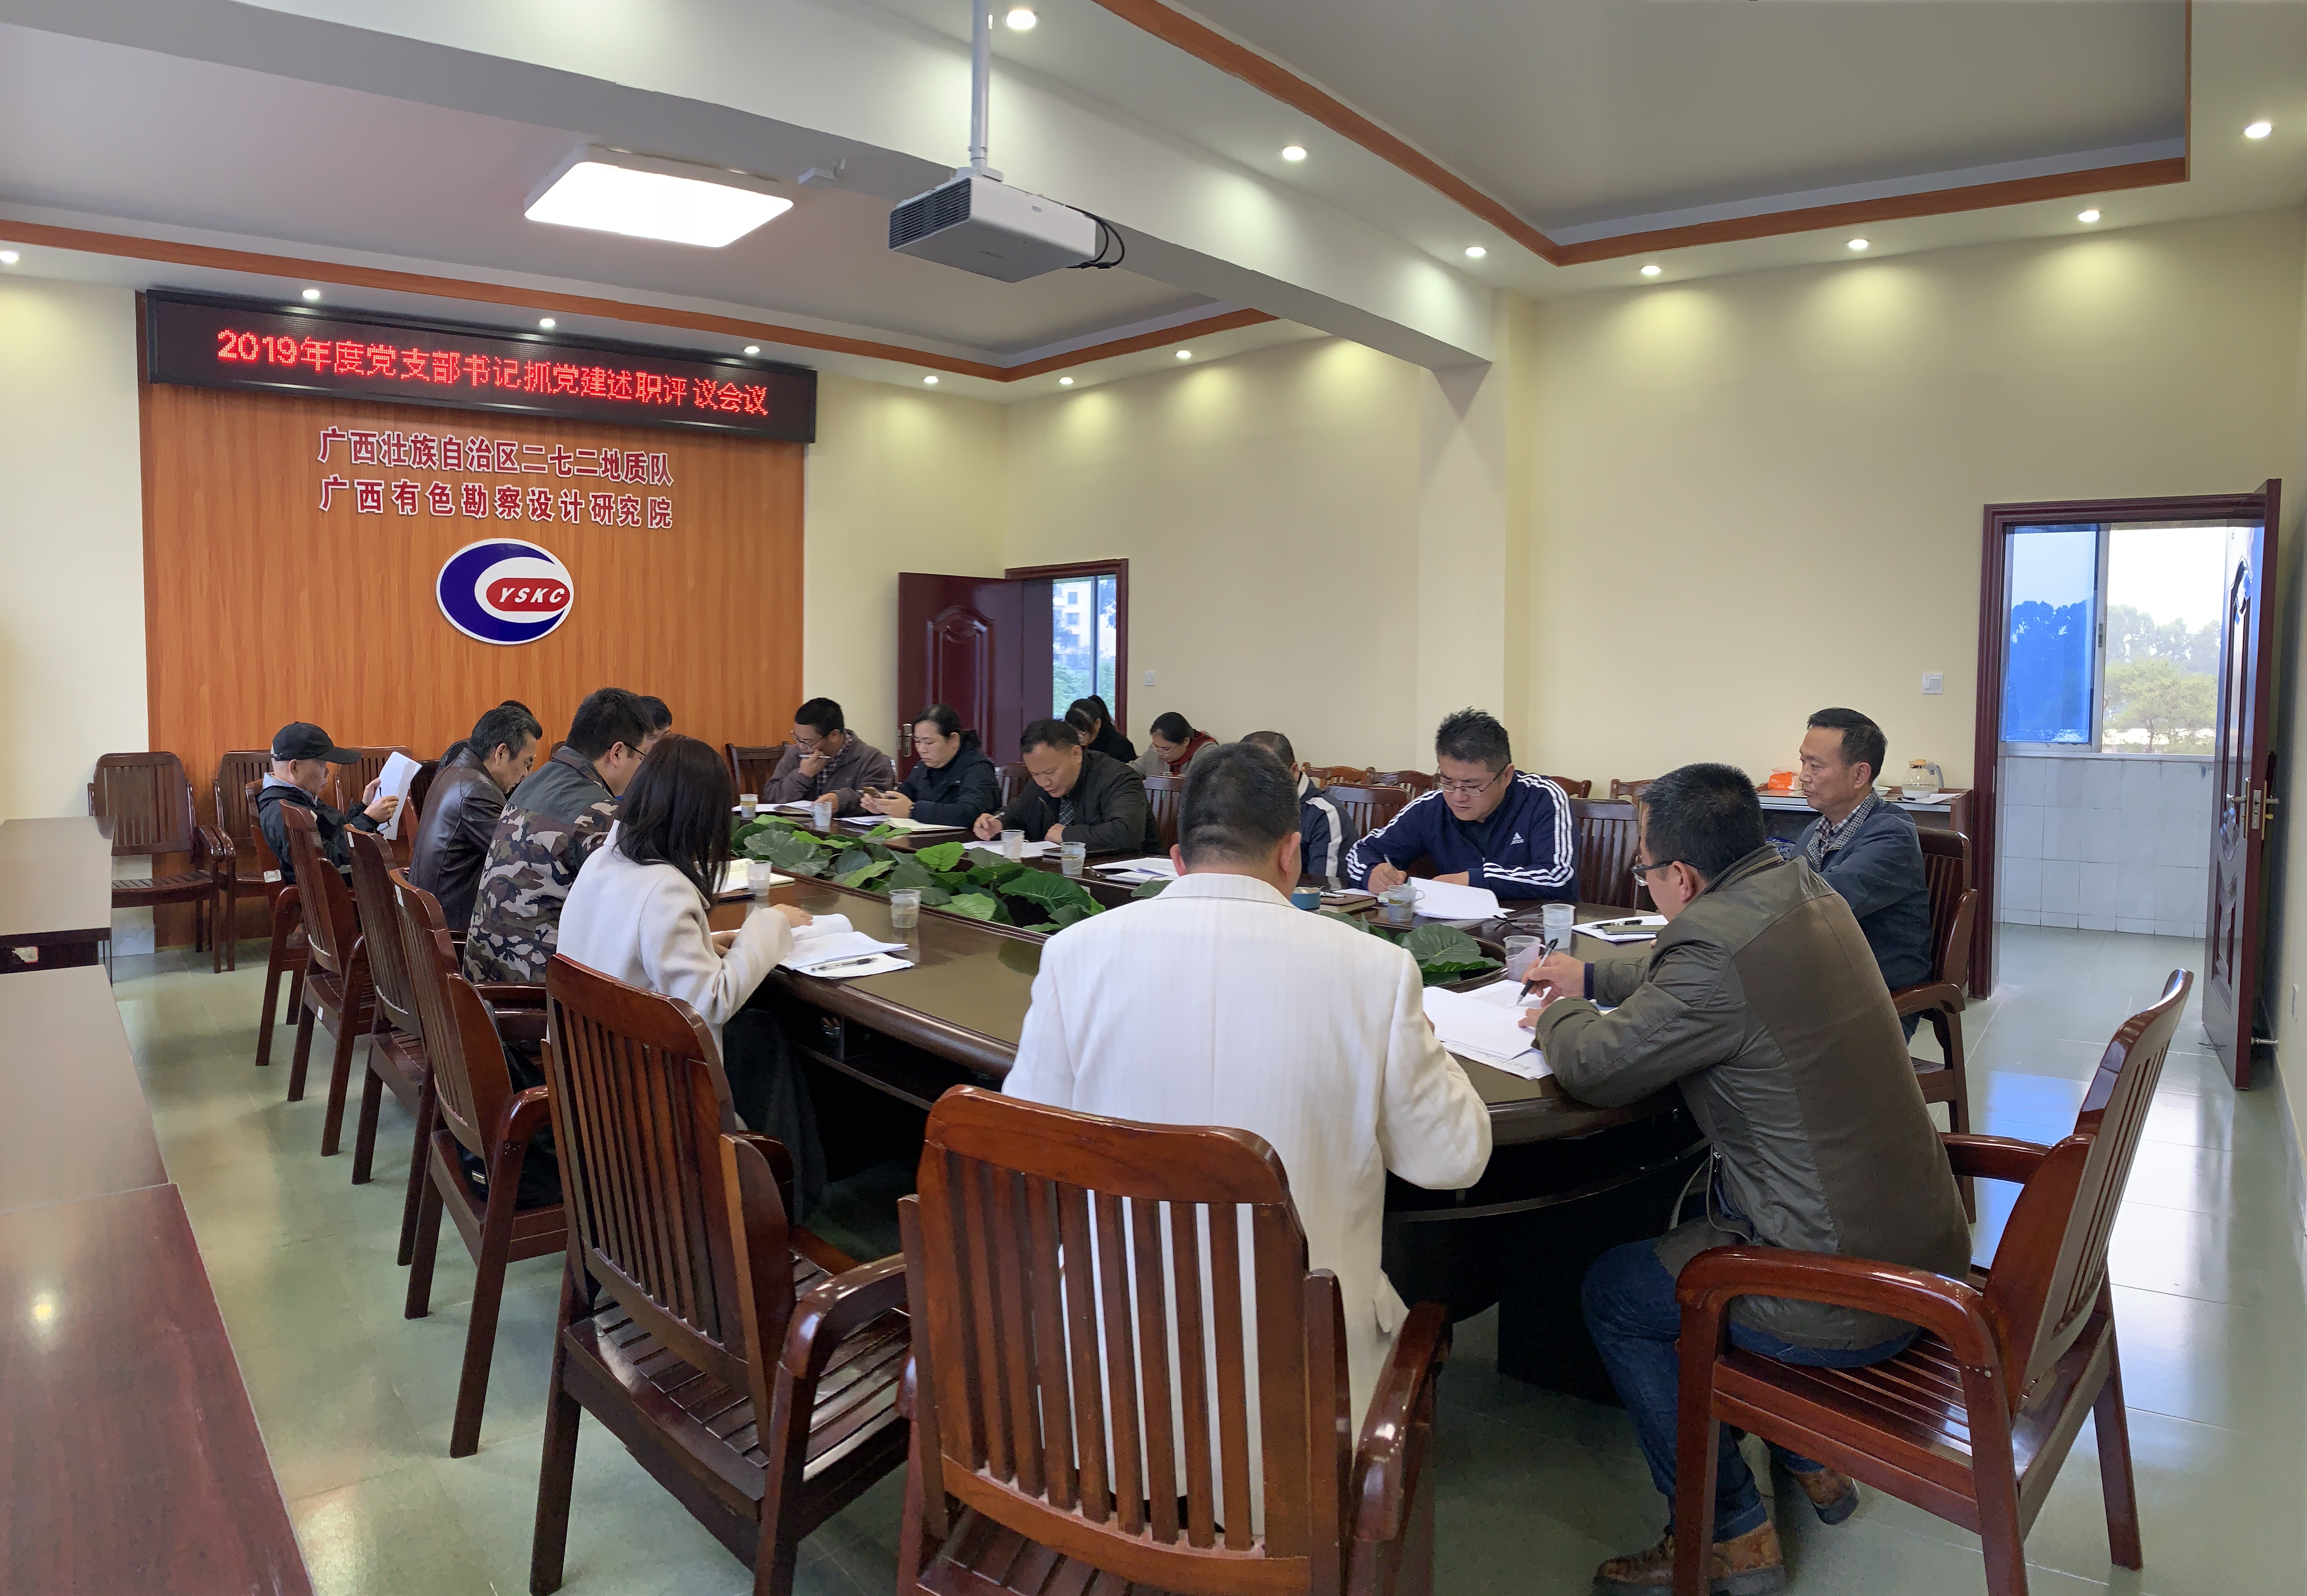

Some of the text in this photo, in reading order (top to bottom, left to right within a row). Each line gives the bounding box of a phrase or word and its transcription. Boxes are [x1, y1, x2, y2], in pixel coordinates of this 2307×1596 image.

[218, 329, 769, 416] 2019年度党支部书记抓党建述职评议会议
[317, 426, 674, 487] 广西壮族自治区二七二地质队
[319, 474, 673, 529] 广西有色勘察设计研究院
[499, 588, 565, 603] YSKC
